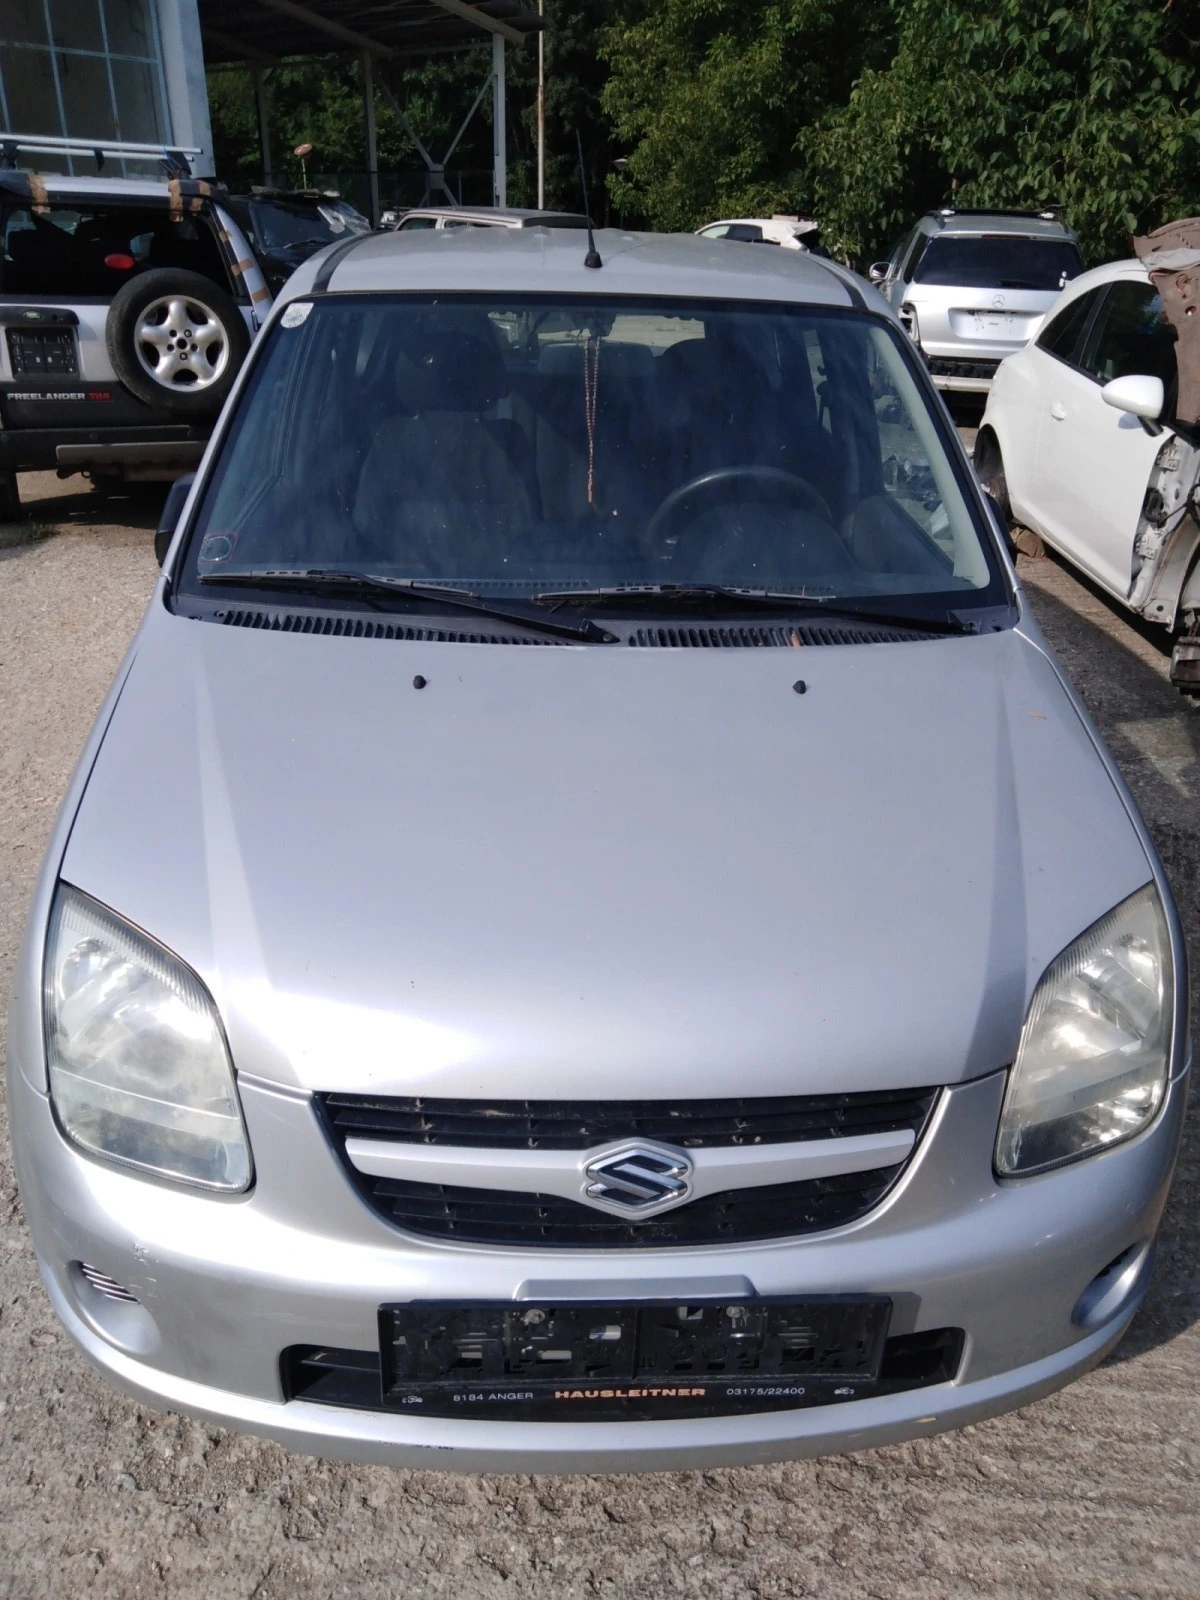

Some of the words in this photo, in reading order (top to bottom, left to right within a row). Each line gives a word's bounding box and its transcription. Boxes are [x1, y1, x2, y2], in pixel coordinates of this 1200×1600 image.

[7, 392, 85, 400] FREELANDER
[452, 1393, 484, 1402] 8184
[488, 1392, 534, 1400] ANGER
[554, 1388, 706, 1399] HAUSLEITNER
[726, 1387, 805, 1396] 03175/22400
